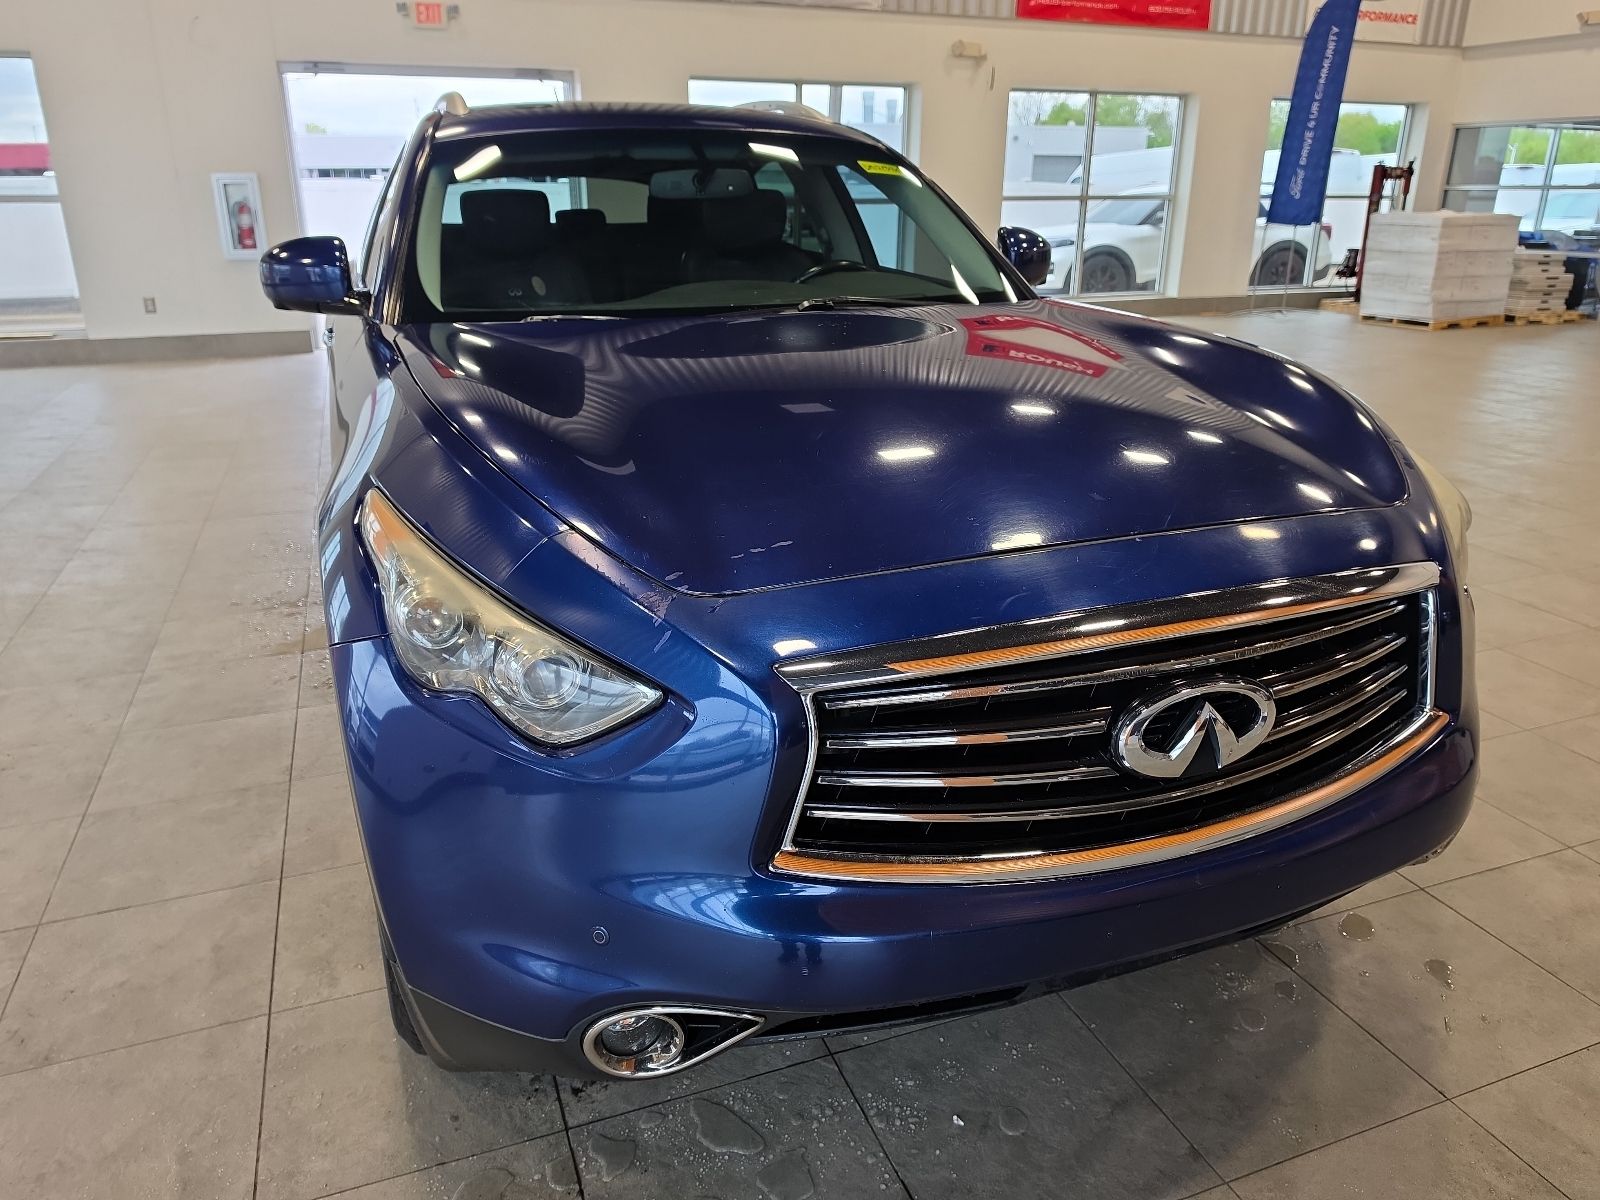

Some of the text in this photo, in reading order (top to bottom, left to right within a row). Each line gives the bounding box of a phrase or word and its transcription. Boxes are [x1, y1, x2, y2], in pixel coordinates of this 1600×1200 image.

[416, 3, 441, 24] EXIT
[1358, 10, 1418, 25] RFORMANCE
[1299, 130, 1314, 165] DRIVE
[1314, 25, 1340, 99] COMMUNITY
